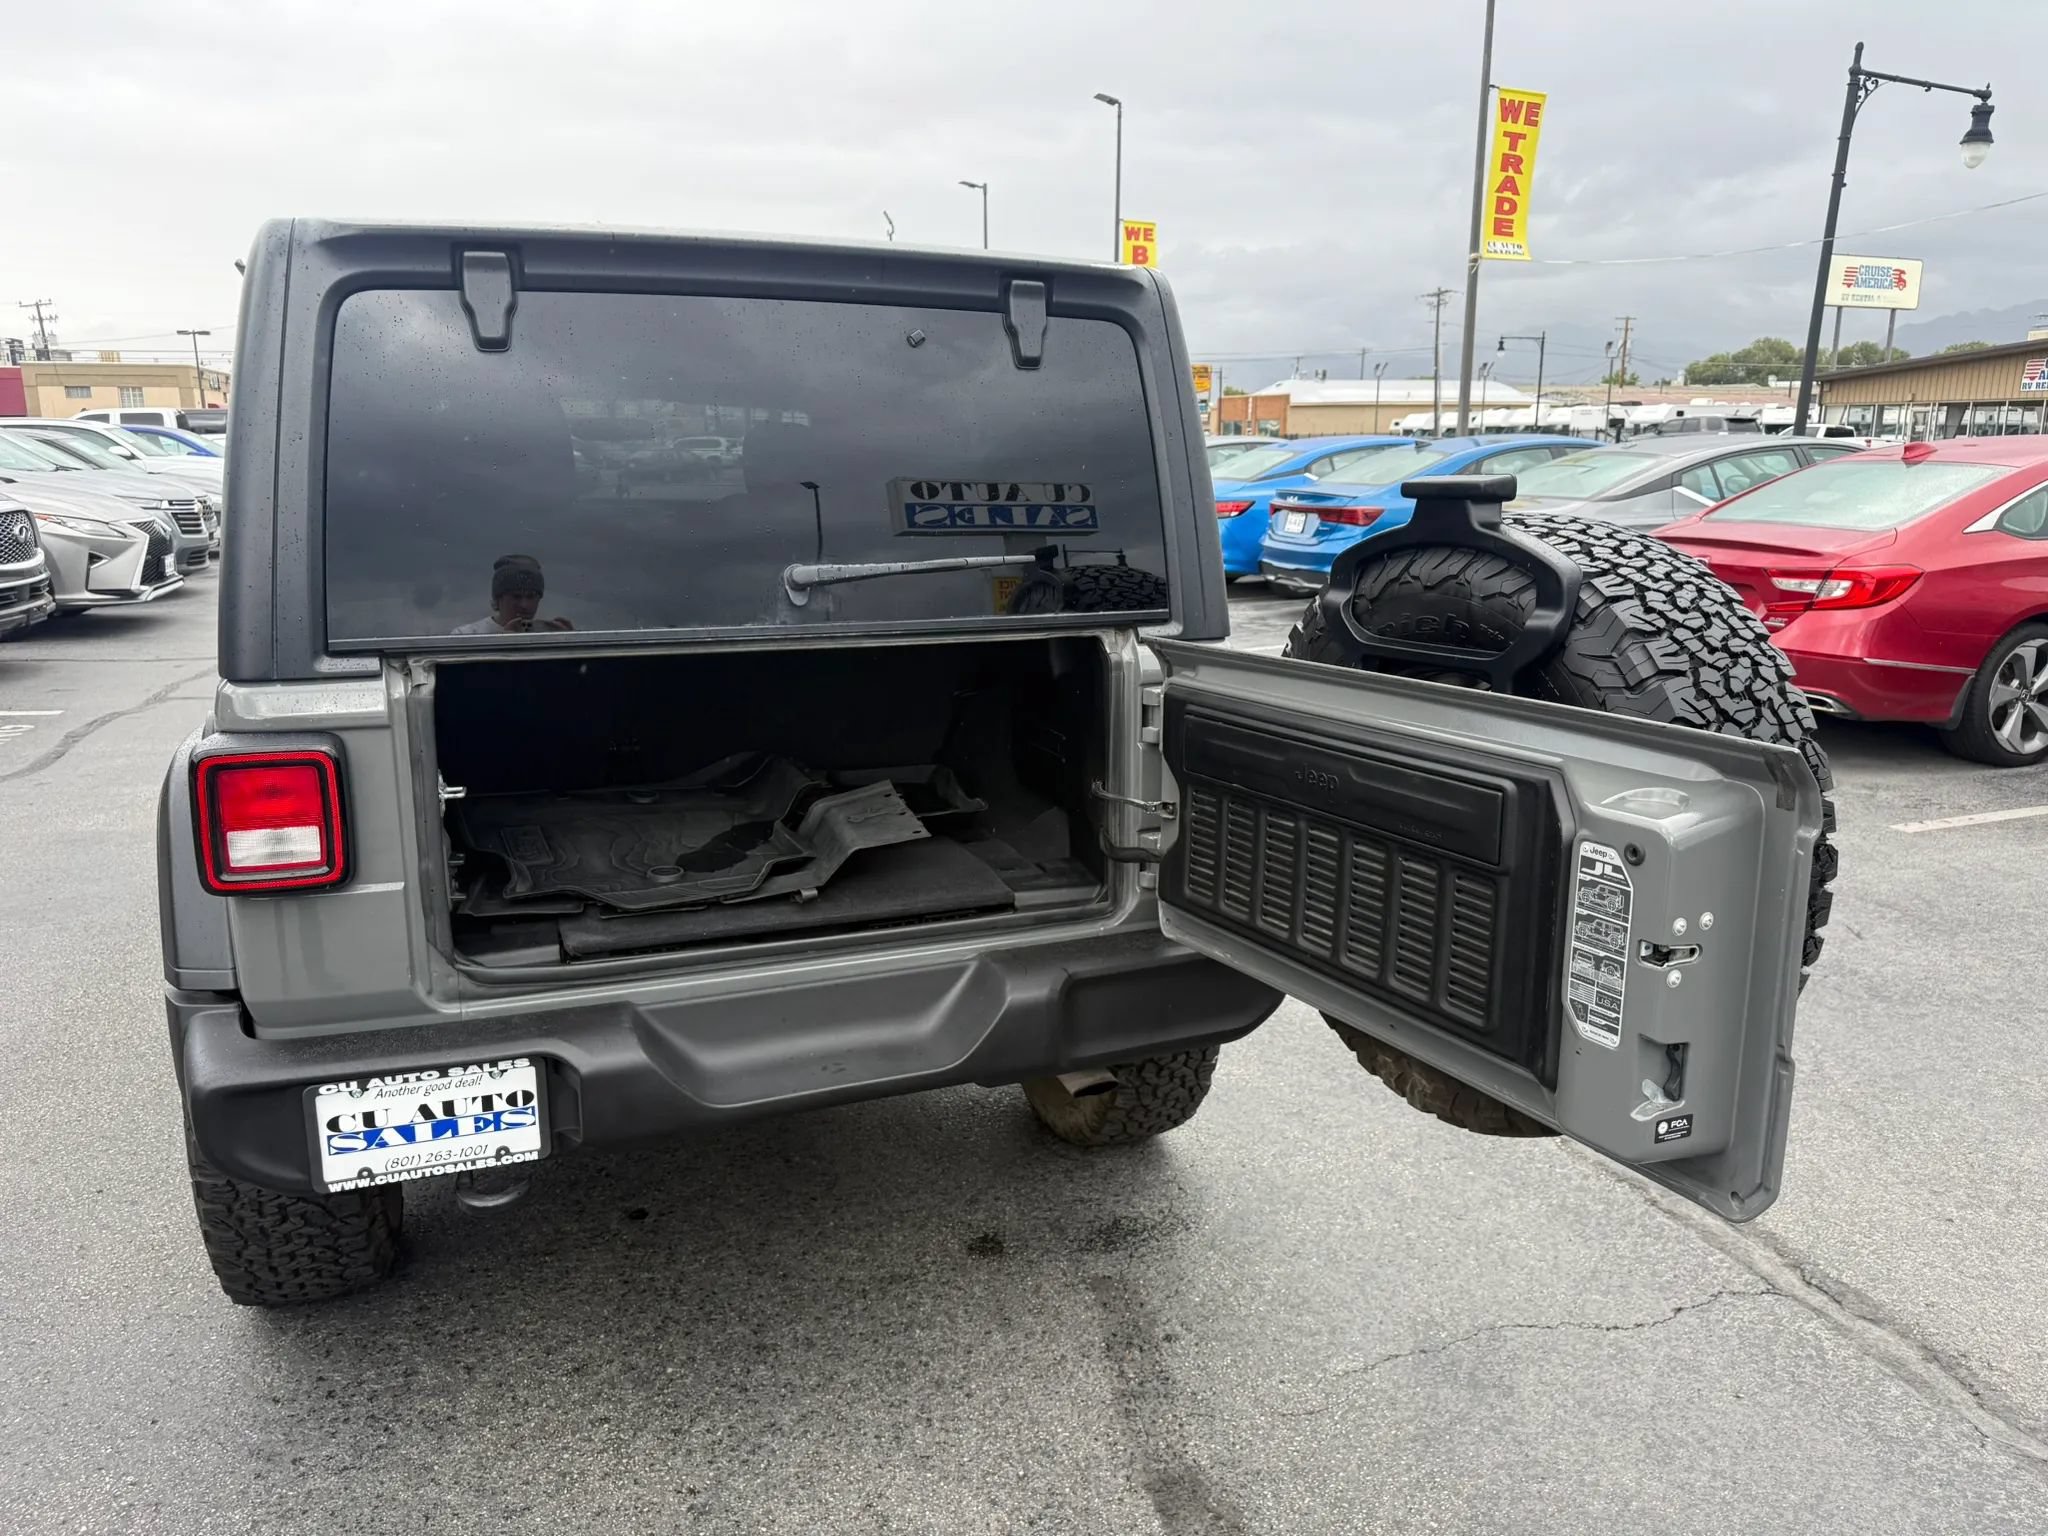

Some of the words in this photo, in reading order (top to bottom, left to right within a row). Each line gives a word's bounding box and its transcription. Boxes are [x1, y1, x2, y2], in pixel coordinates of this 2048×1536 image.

[1500, 98, 1541, 127] WE
[1493, 130, 1527, 237] TRADE
[1125, 226, 1154, 242] WE
[1853, 275, 1894, 290] AMERICA
[1858, 264, 1893, 278] CRUISE
[2021, 382, 2033, 390] RV
[1589, 846, 1608, 859] Jeep
[1580, 861, 1626, 881] JL
[318, 1081, 358, 1096] CU
[366, 1070, 441, 1088] AUTO
[447, 1057, 531, 1077] SALES
[374, 1084, 424, 1100] Another
[425, 1079, 453, 1097] good
[455, 1074, 483, 1089] deal!
[326, 1108, 393, 1133] CU
[410, 1089, 535, 1123] AUTO
[1670, 1118, 1688, 1129] FCA
[327, 1106, 537, 1156] SALES
[384, 1153, 421, 1172] (801)
[424, 1144, 488, 1164] 263-1001
[328, 1150, 539, 1193] WWW.CUAUTOSALES.COM
